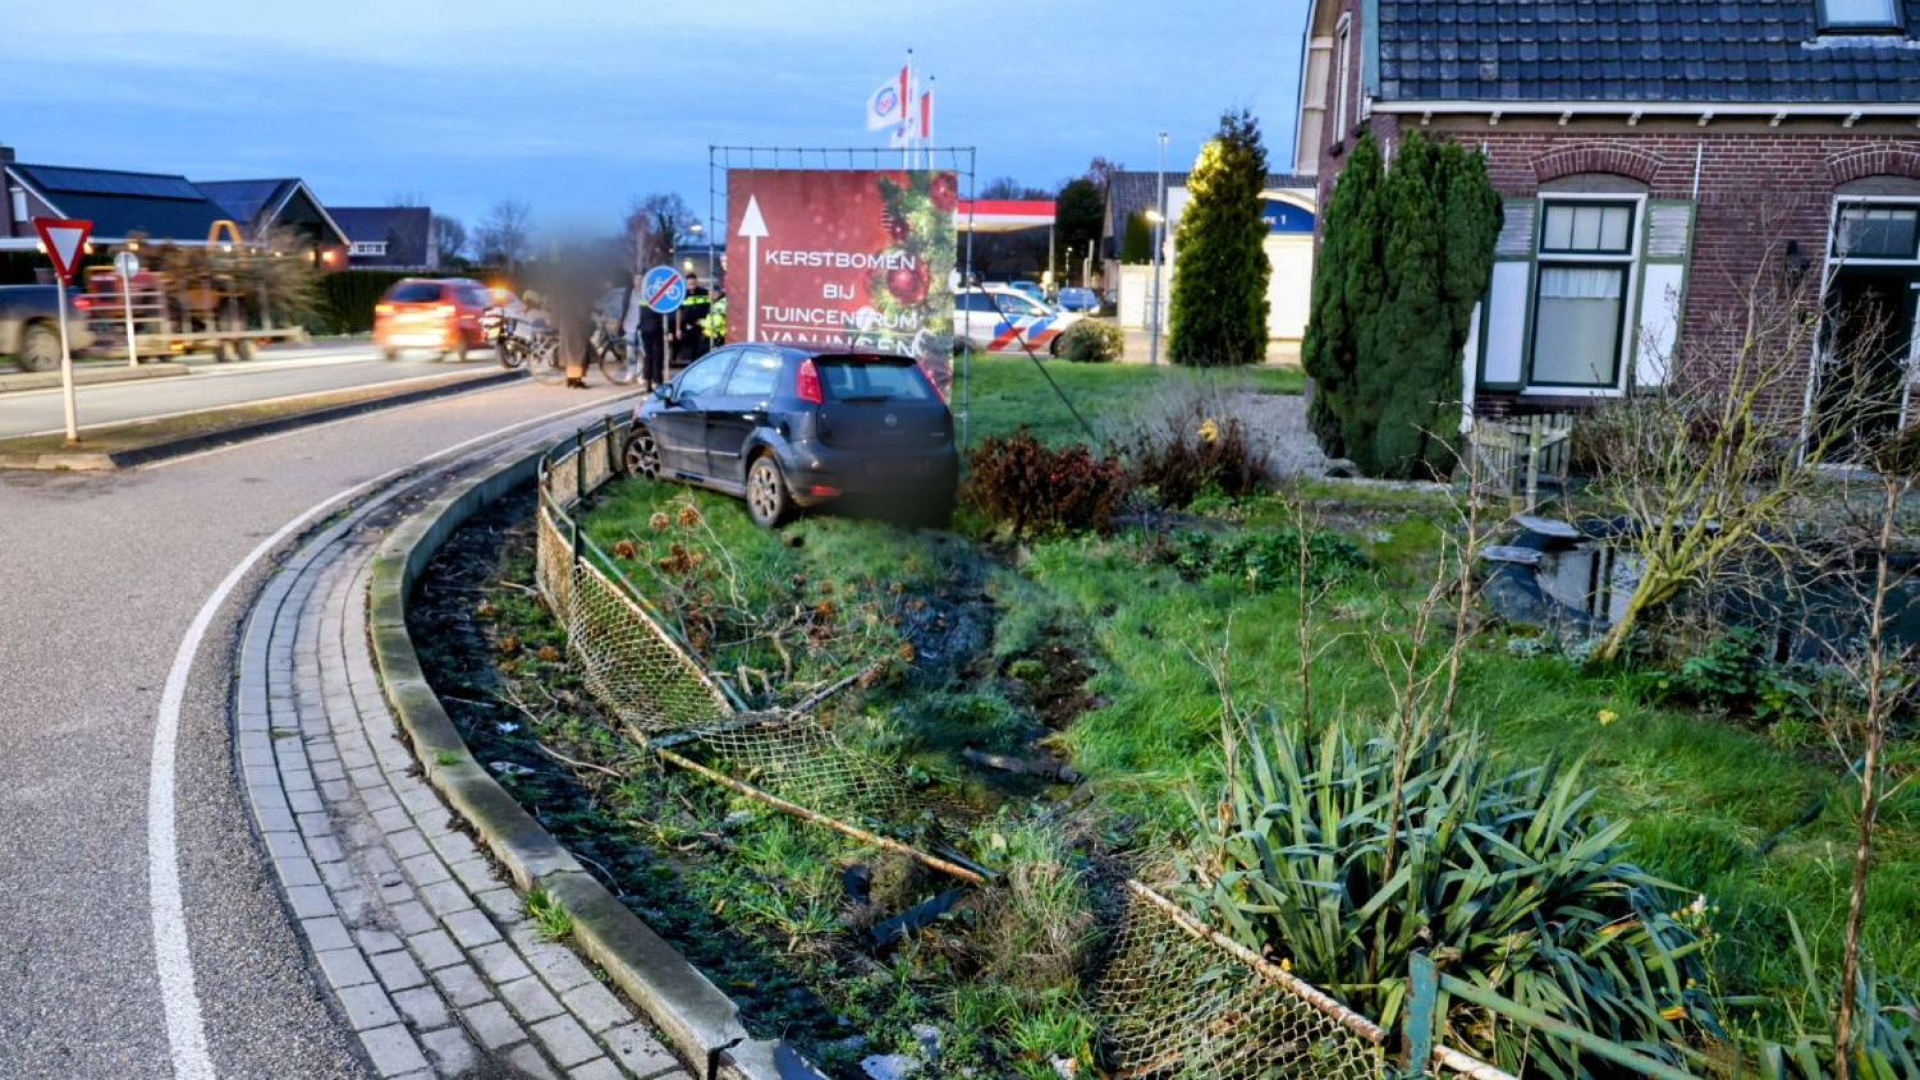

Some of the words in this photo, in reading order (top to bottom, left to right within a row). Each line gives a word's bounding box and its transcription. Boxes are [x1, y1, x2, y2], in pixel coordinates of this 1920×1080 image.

[765, 250, 916, 270] KERSTBOMEN
[823, 284, 855, 300] BIJ
[761, 306, 918, 328] TUINCENTRUM
